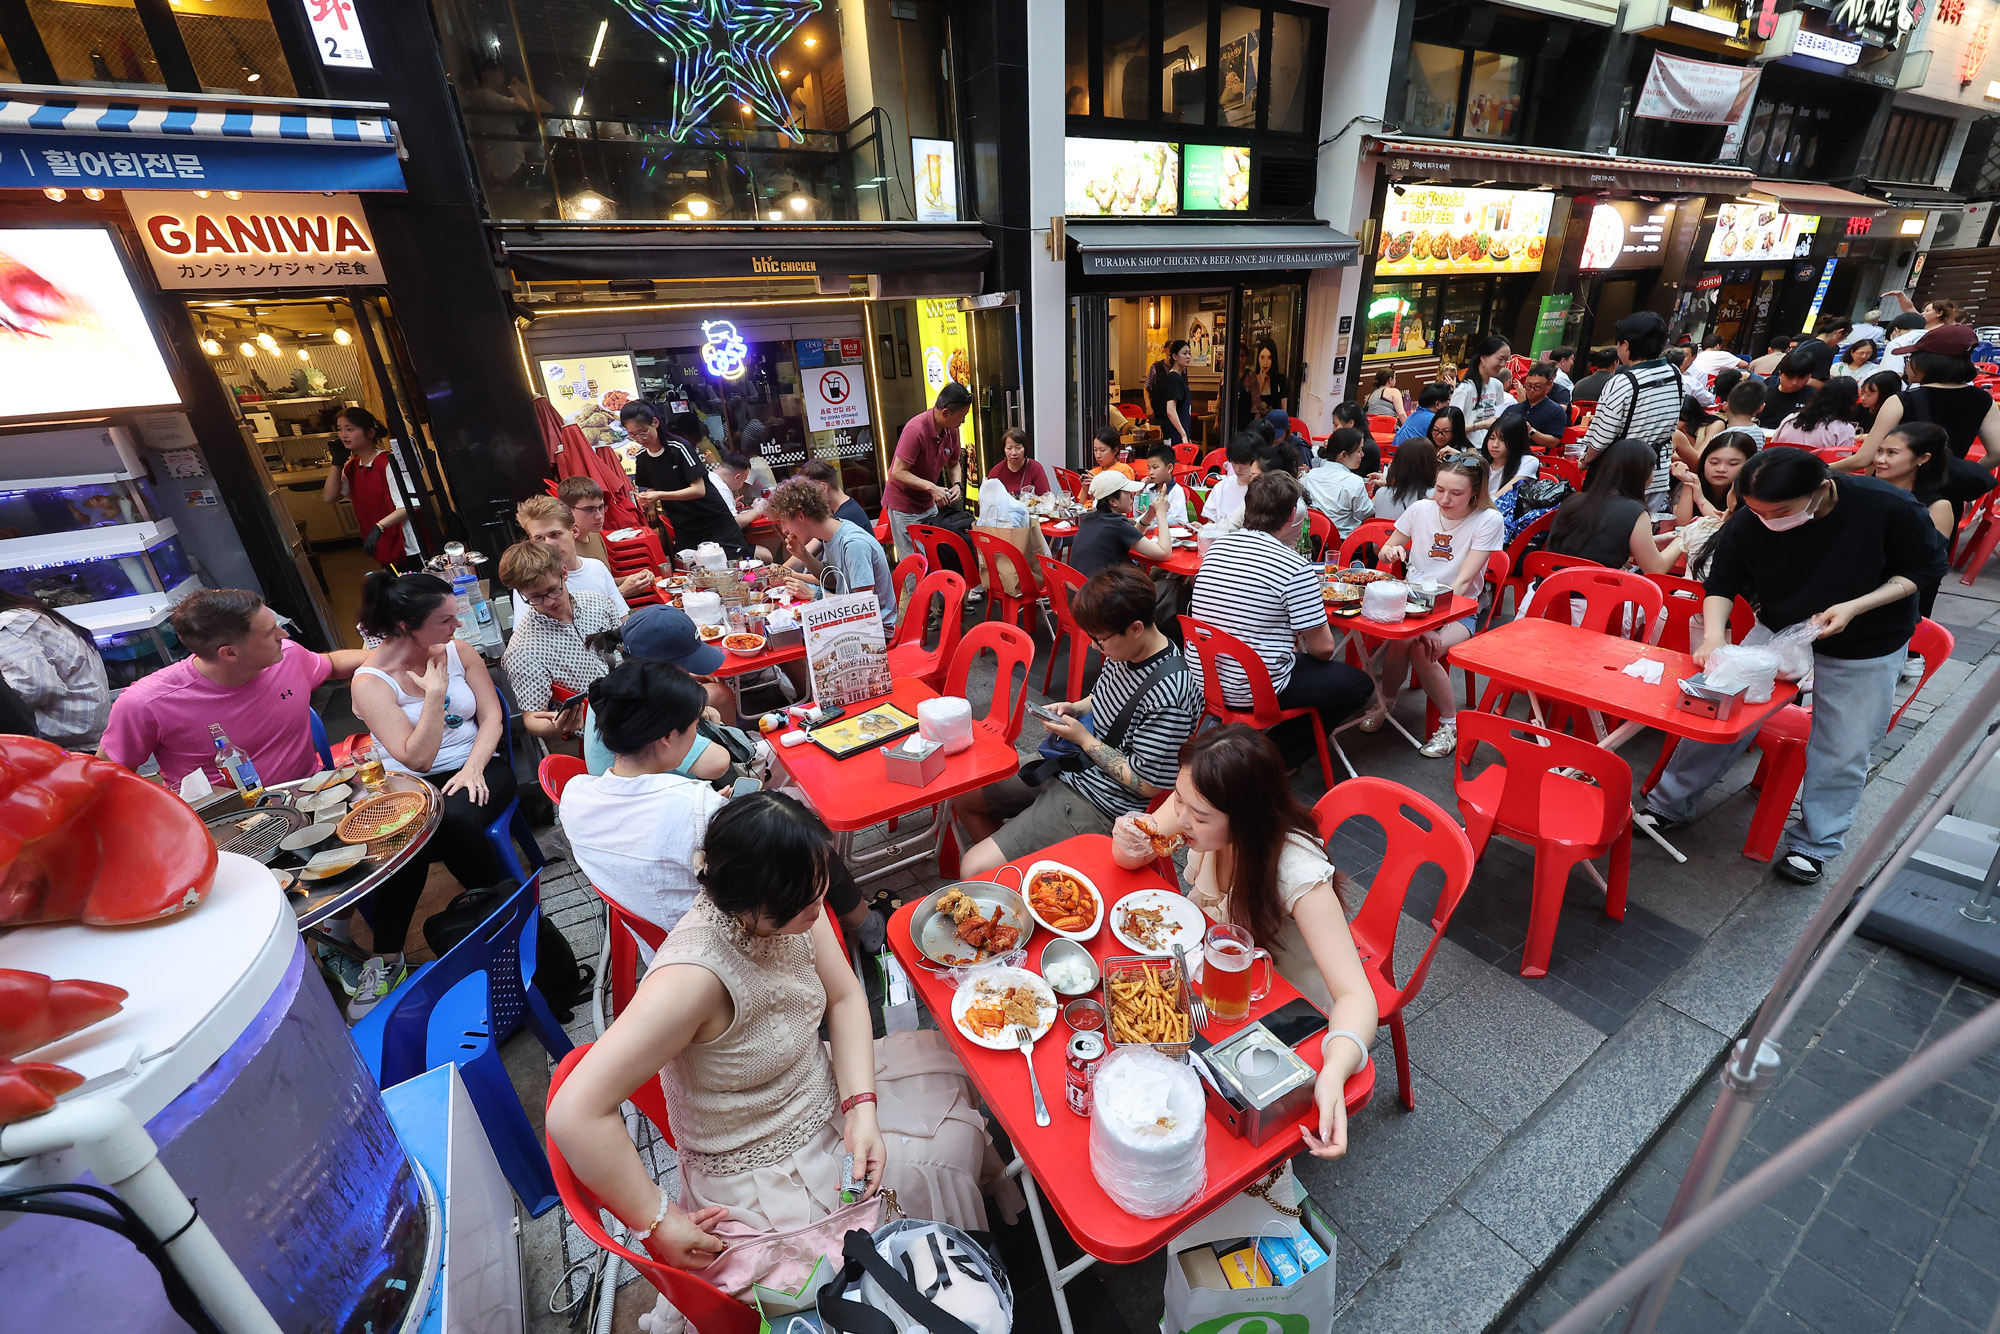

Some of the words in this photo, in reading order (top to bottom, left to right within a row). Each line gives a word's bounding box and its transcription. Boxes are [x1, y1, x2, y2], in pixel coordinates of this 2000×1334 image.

[41, 149, 206, 179] 활어회전문
[1428, 190, 1466, 210] Tongdak
[1408, 209, 1435, 224] CRAFT
[1434, 210, 1455, 224] BEER
[147, 214, 373, 255] GANIWA
[751, 255, 780, 273] bhc
[780, 261, 817, 272] CHICKEN
[1094, 257, 1137, 267] PURADAK
[1138, 256, 1162, 267] SHOP
[1162, 256, 1200, 266] CHICKEN
[1201, 256, 1208, 265] &
[1209, 255, 1230, 265] BEER
[1234, 254, 1257, 264] SINCE
[1258, 254, 1272, 264] 2014
[1277, 253, 1310, 263] PURADAK
[1311, 252, 1333, 262] LOVES
[1333, 251, 1351, 261] YOU!
[177, 260, 369, 279] カンジャンケジャン定食
[1798, 269, 1813, 277] ADT
[843, 343, 858, 351] 에스원
[683, 366, 699, 376] bhc
[928, 368, 943, 383] BHC
[558, 374, 599, 400] 뿌링클
[820, 407, 831, 415] 음료
[832, 406, 844, 414] 반입
[832, 431, 852, 447] bhc
[759, 439, 782, 456] bhc
[808, 600, 876, 626] SHINSEGAE
[833, 635, 860, 647] SHINSEGAE
